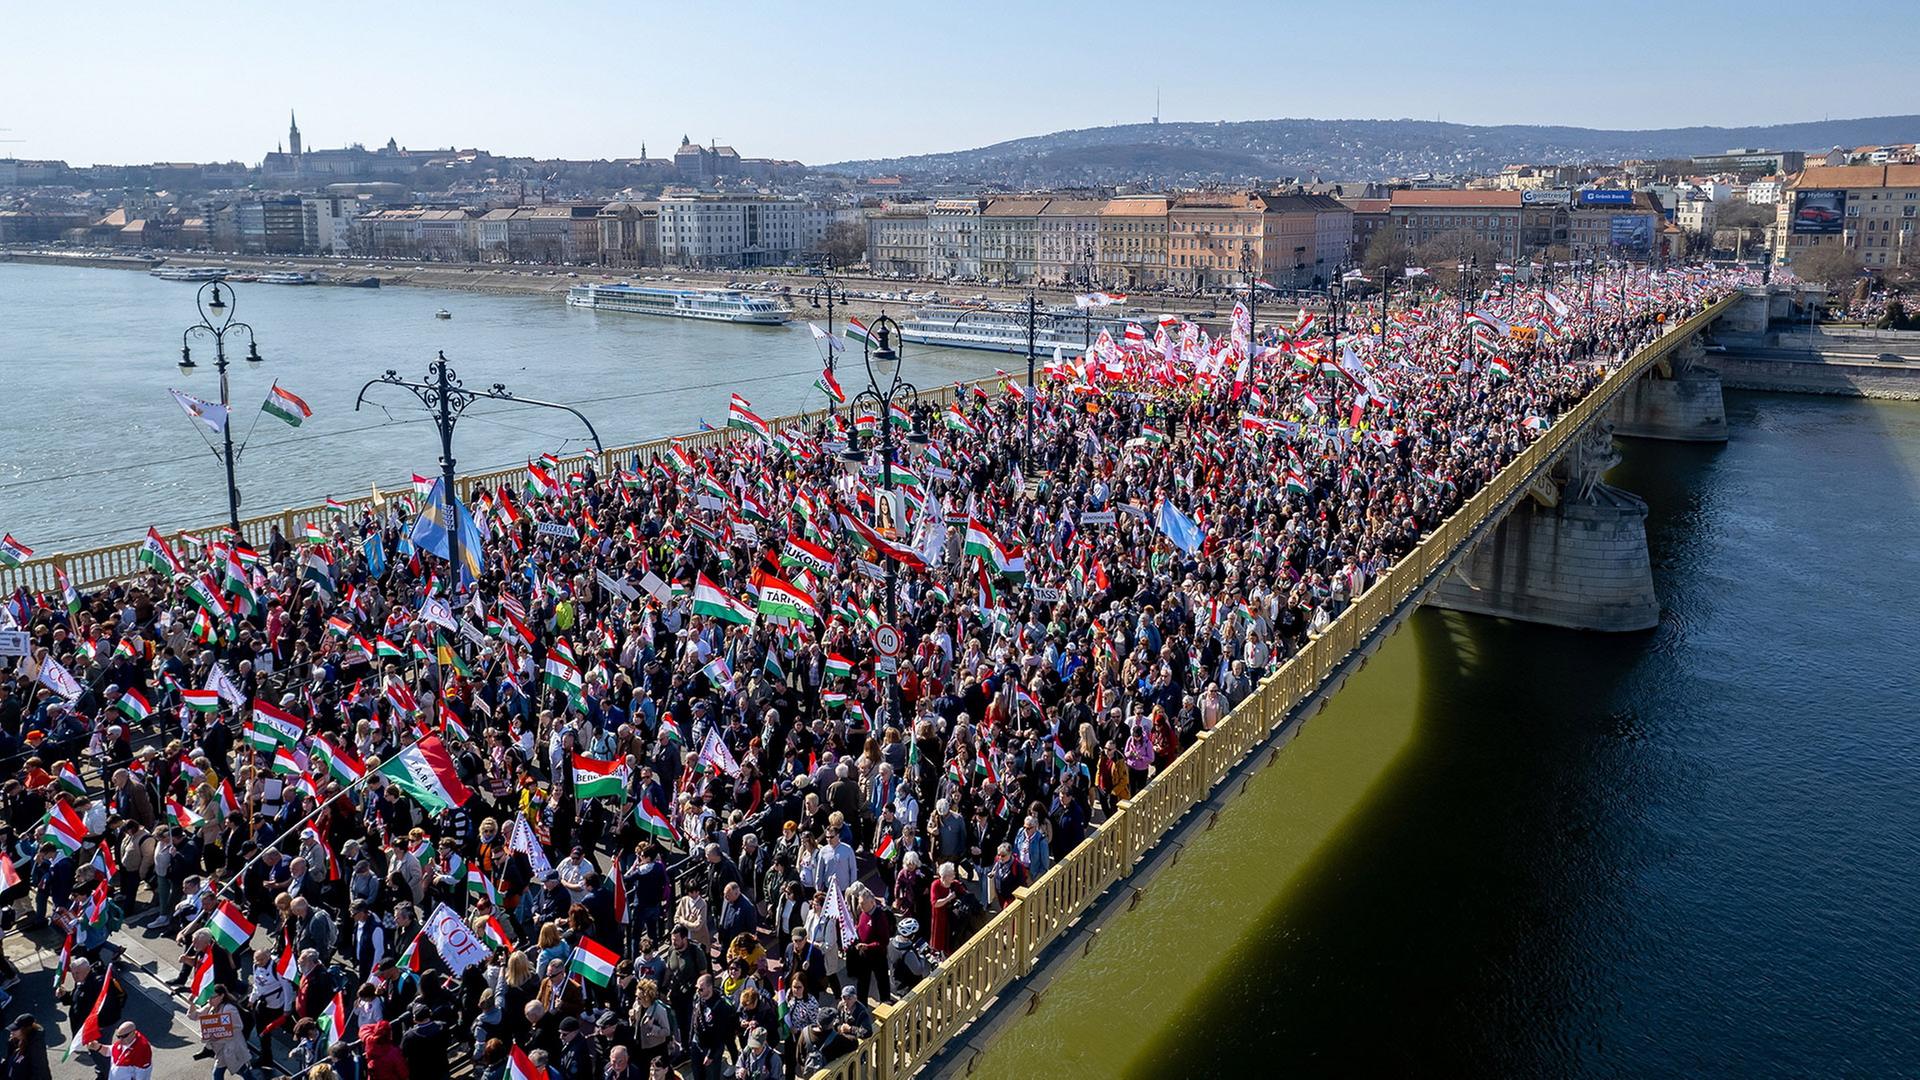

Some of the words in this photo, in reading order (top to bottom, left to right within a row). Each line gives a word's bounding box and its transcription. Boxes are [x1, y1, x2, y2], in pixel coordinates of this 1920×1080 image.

[1035, 589, 1057, 600] TASS
[881, 634, 894, 647] 40
[440, 916, 478, 955] COF
